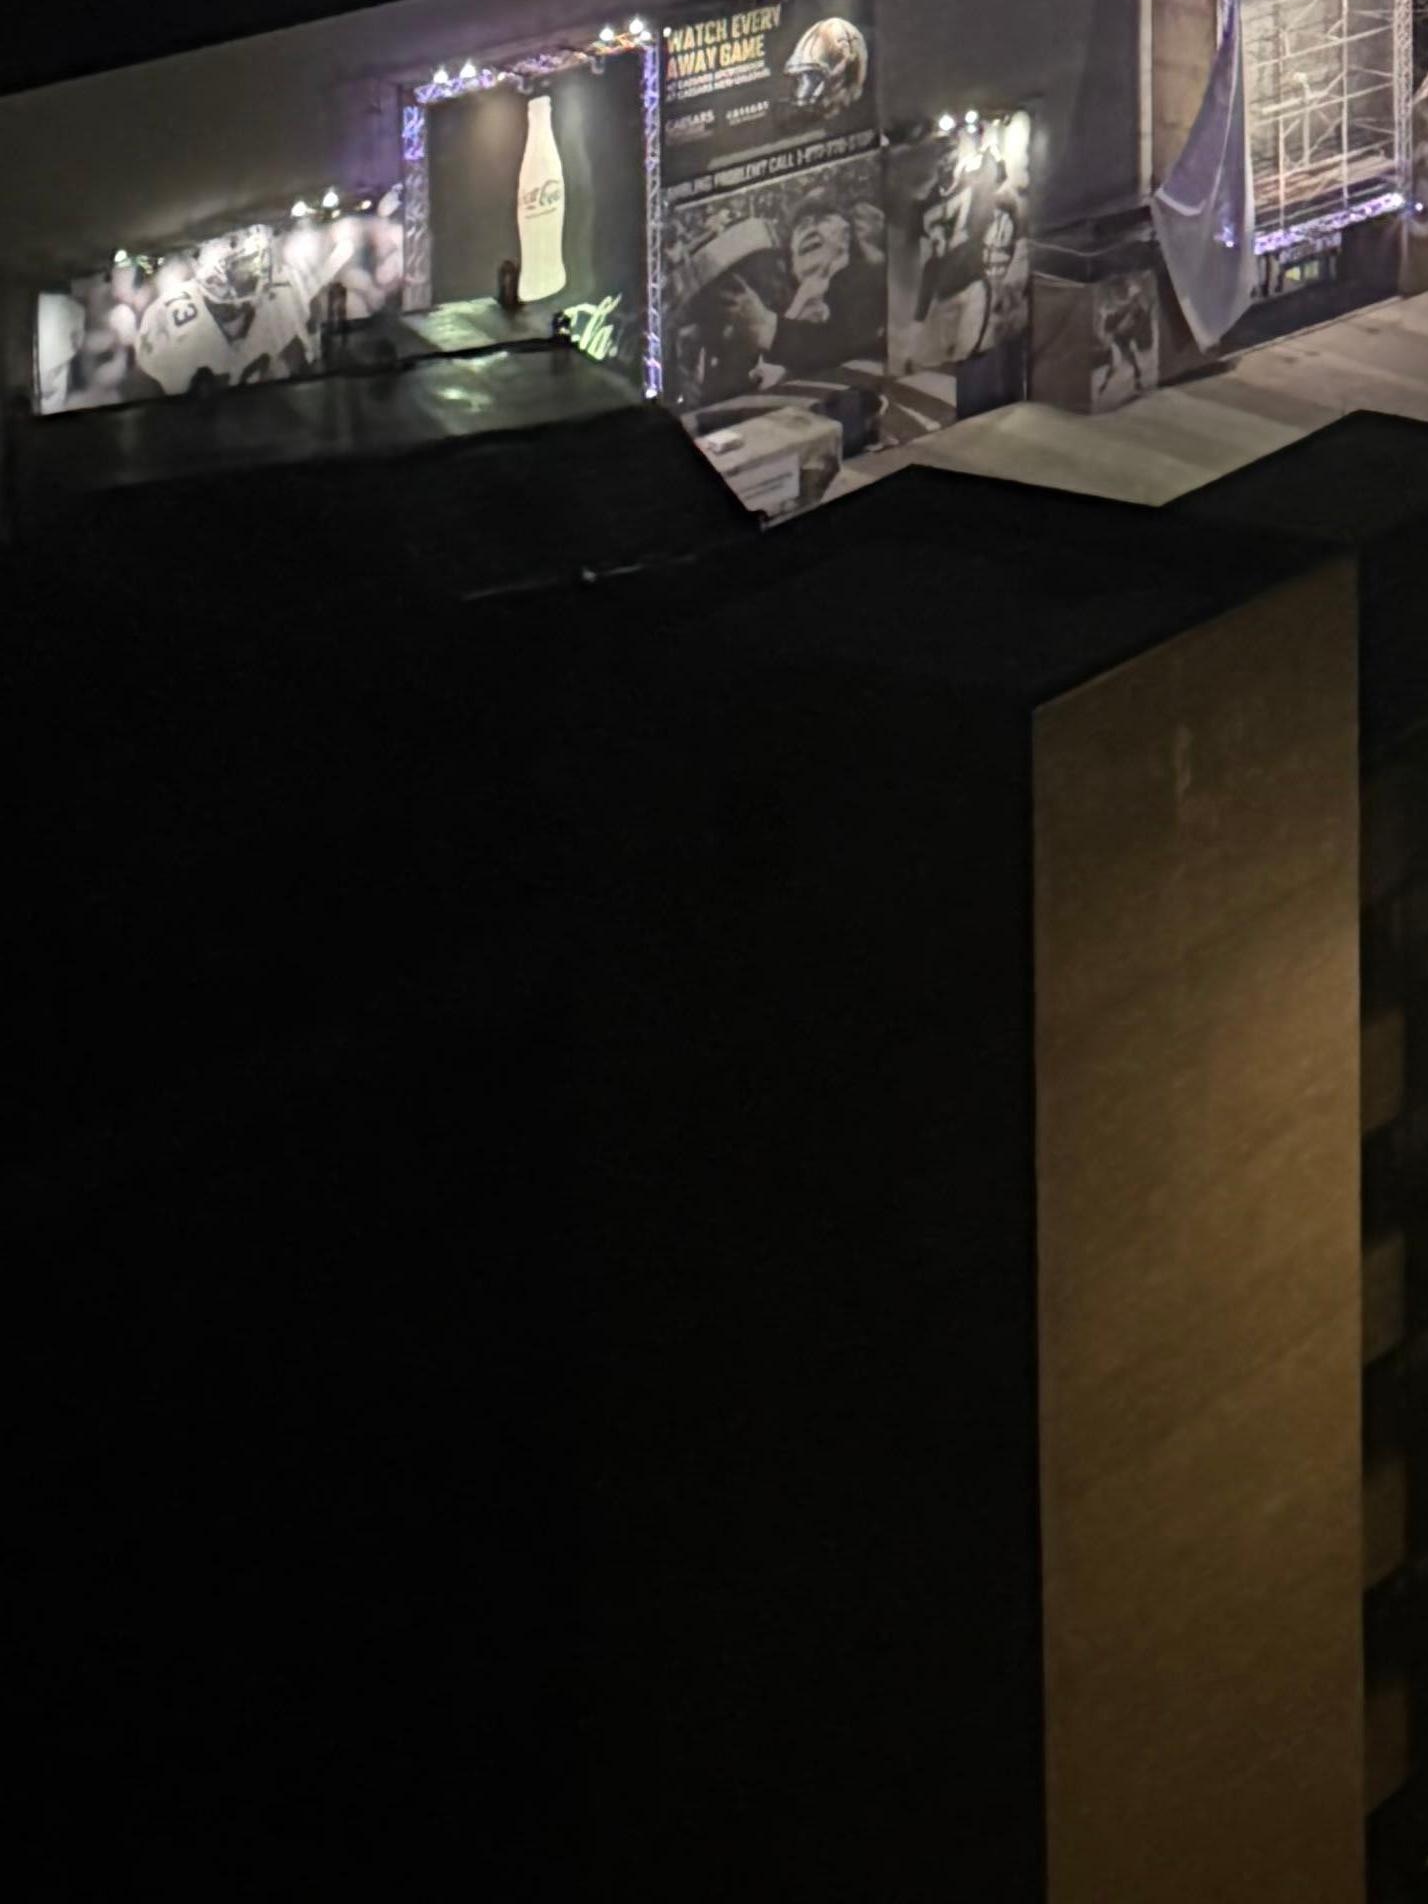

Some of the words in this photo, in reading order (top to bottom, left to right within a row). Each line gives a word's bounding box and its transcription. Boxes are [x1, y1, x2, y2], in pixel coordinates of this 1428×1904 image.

[668, 19, 728, 54] WATCH
[731, 4, 782, 36] EVERY
[666, 47, 718, 81] AWAY
[719, 34, 766, 67] GAME
